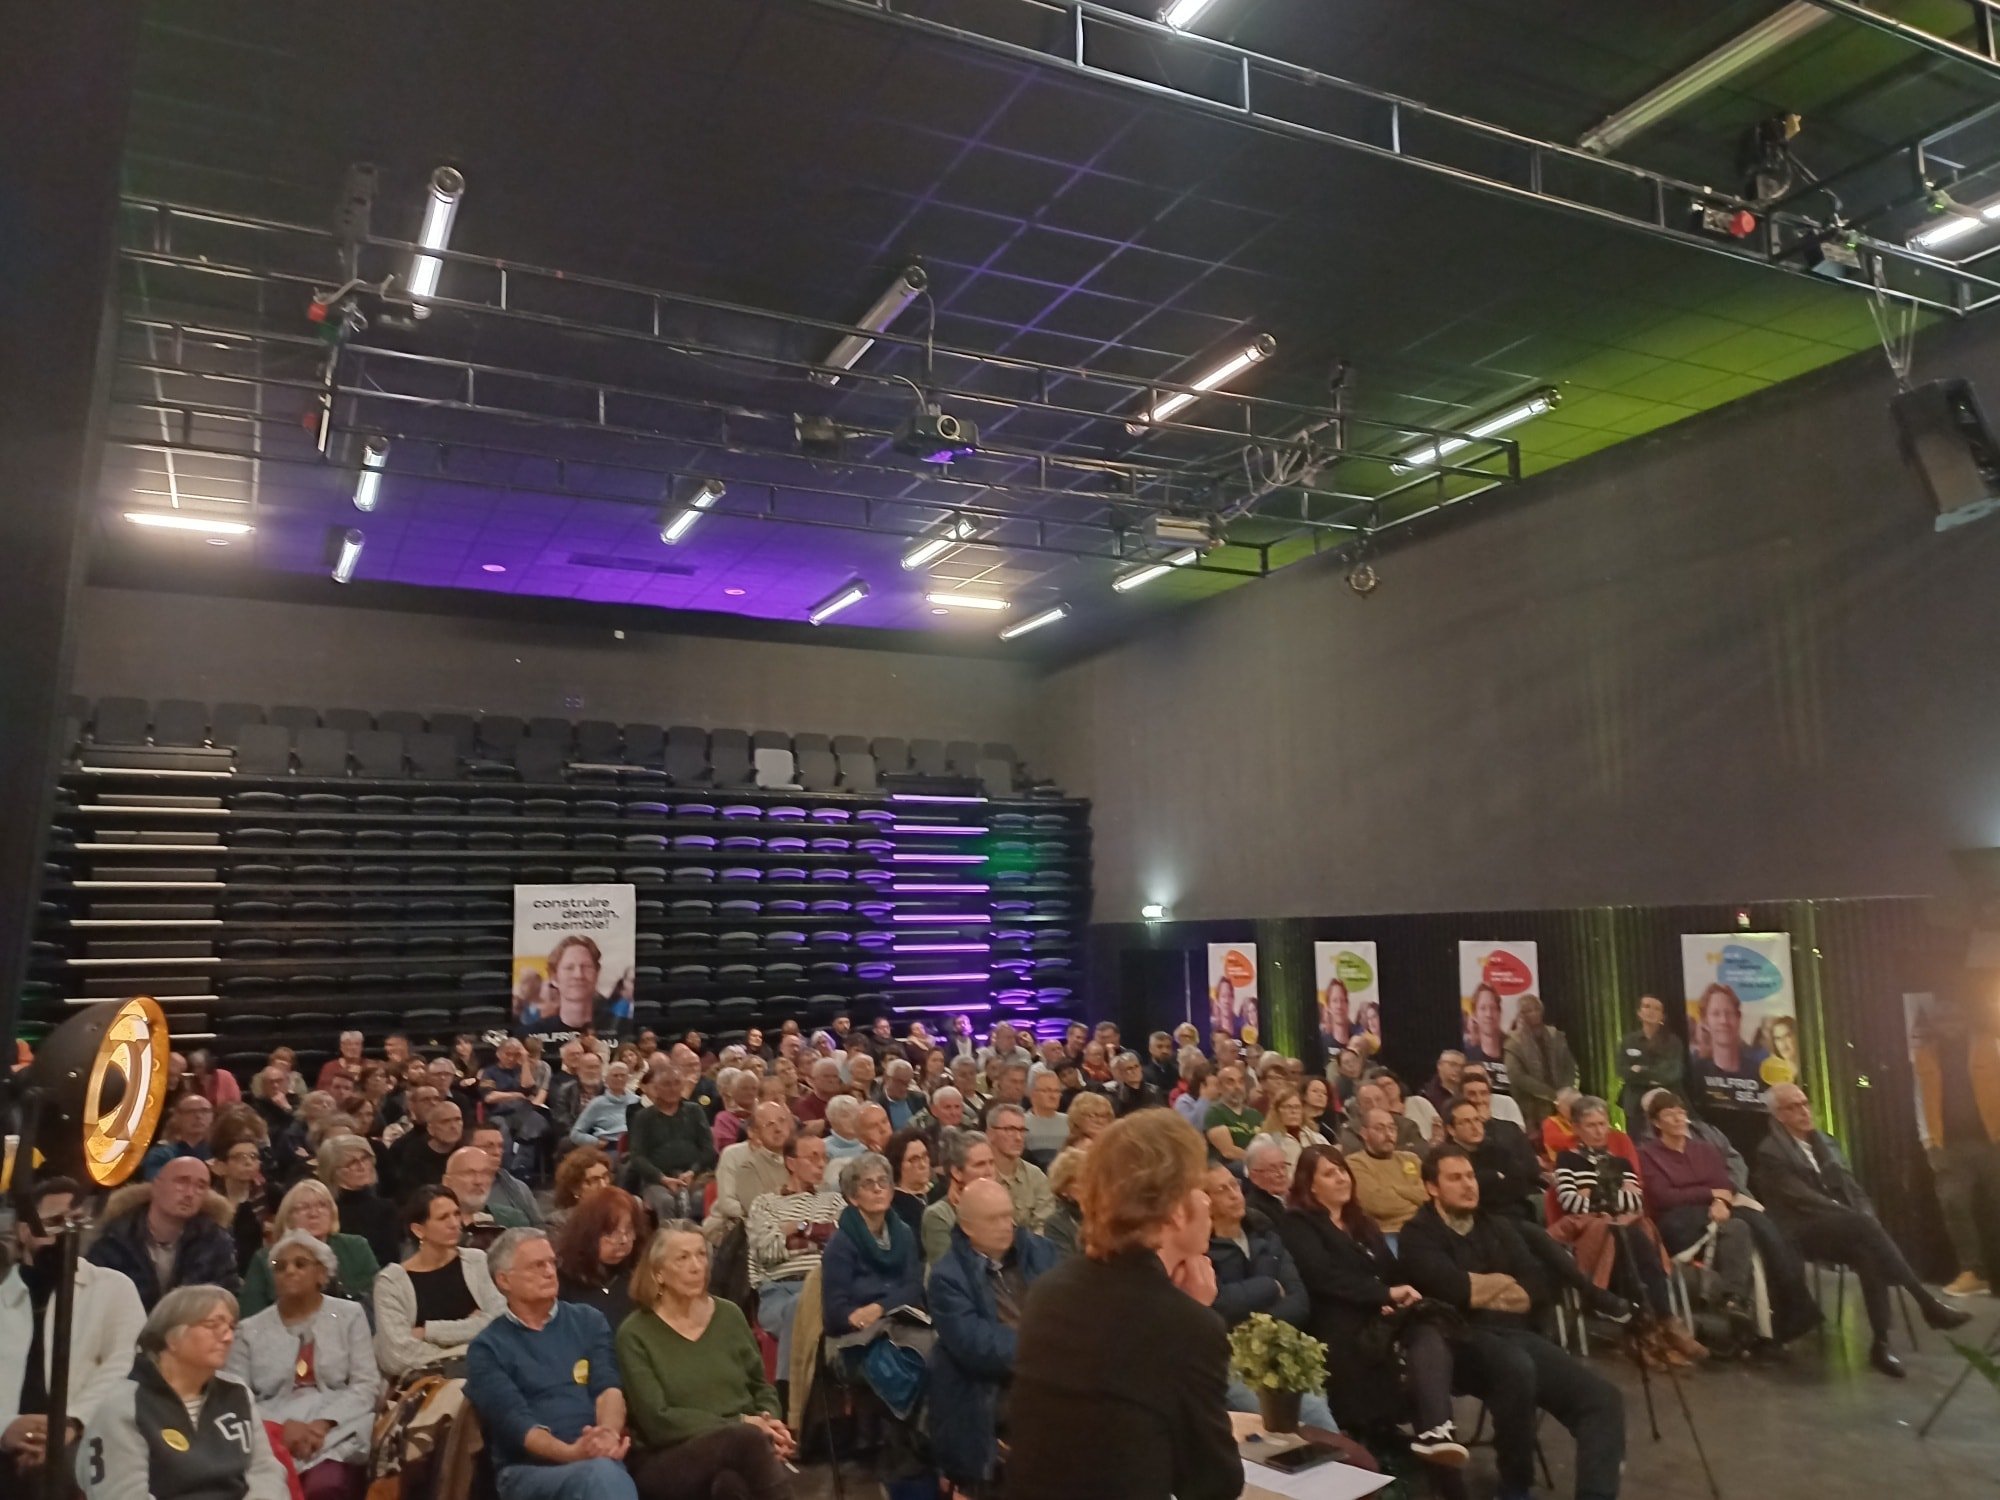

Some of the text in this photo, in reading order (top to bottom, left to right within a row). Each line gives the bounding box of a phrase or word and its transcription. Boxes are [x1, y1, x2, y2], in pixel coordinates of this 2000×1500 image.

[533, 898, 610, 909] construire
[562, 908, 620, 919] demain,
[533, 920, 609, 931] ensemble!
